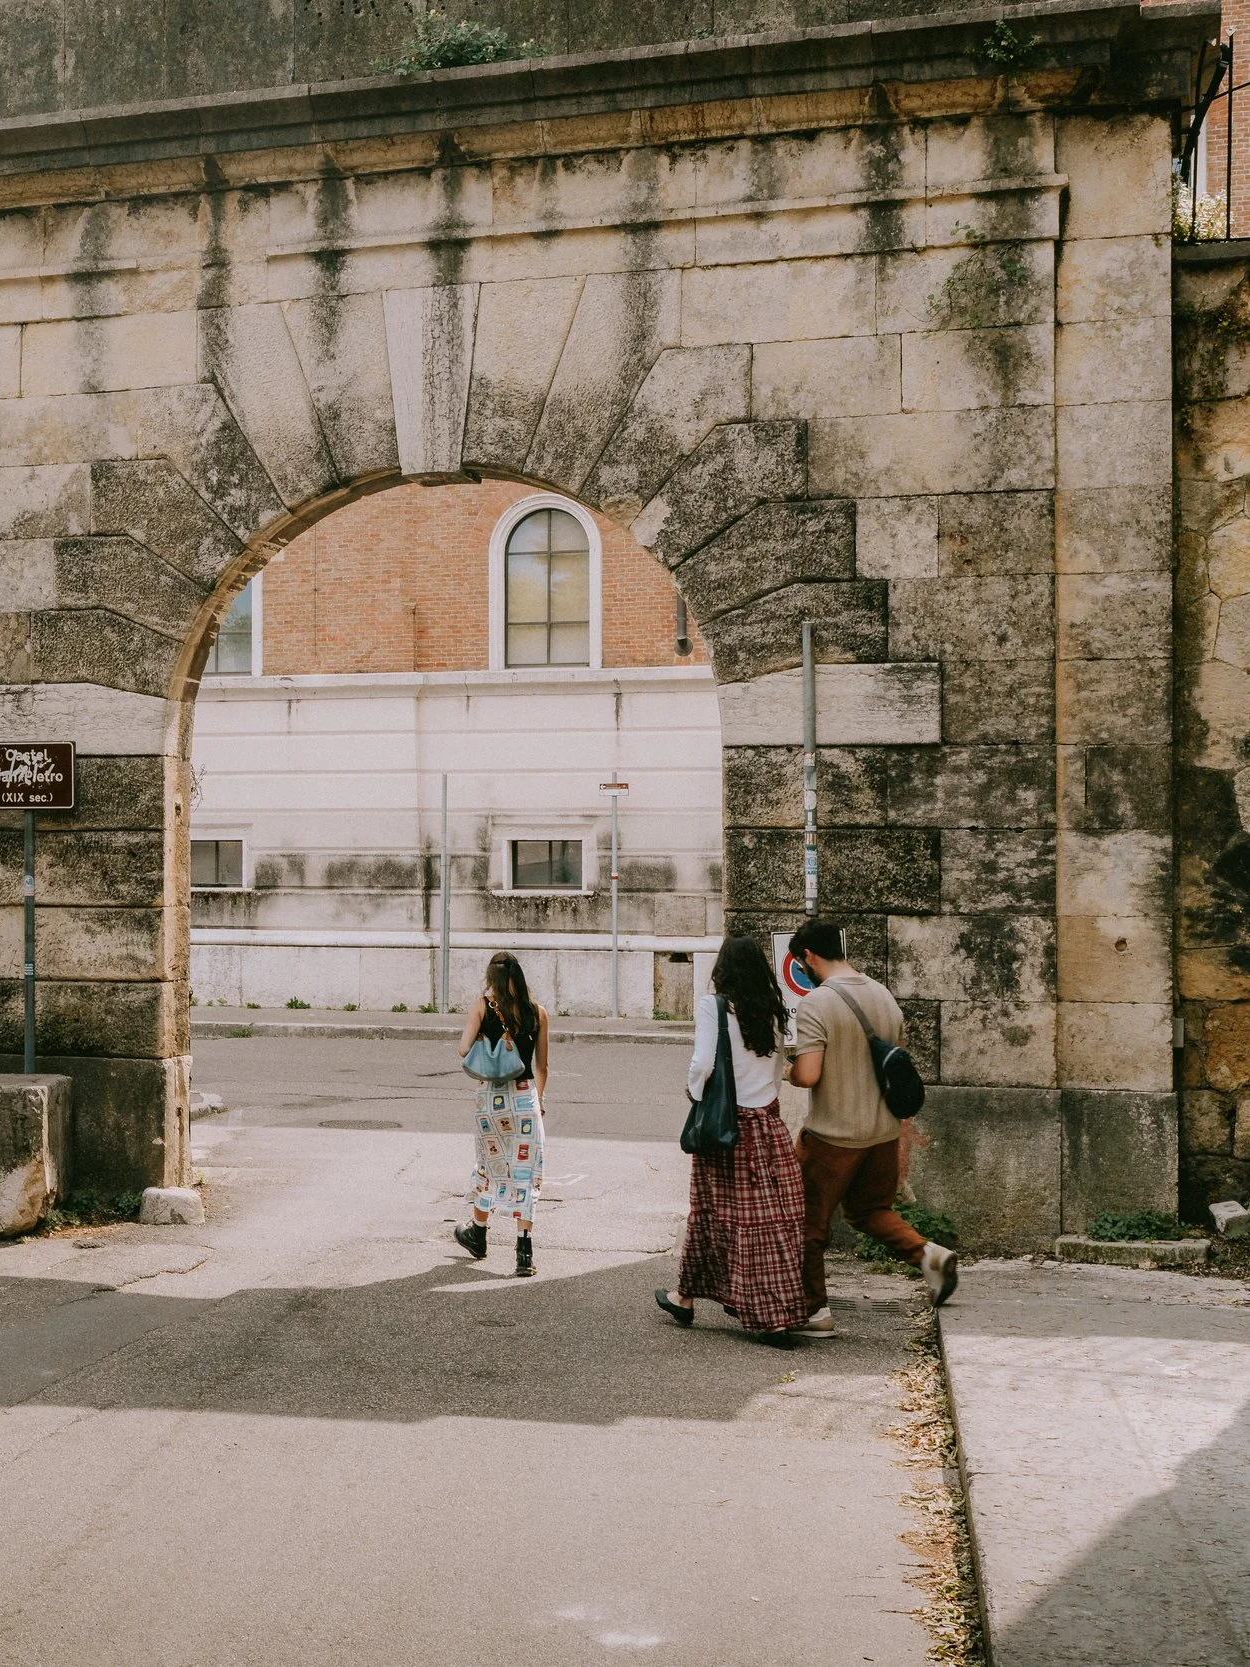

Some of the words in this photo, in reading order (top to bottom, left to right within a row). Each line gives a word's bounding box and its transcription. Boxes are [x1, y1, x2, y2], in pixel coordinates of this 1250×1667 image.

[5, 749, 49, 761] Castel
[1, 792, 24, 803] (XIX
[29, 792, 53, 803] sec.)
